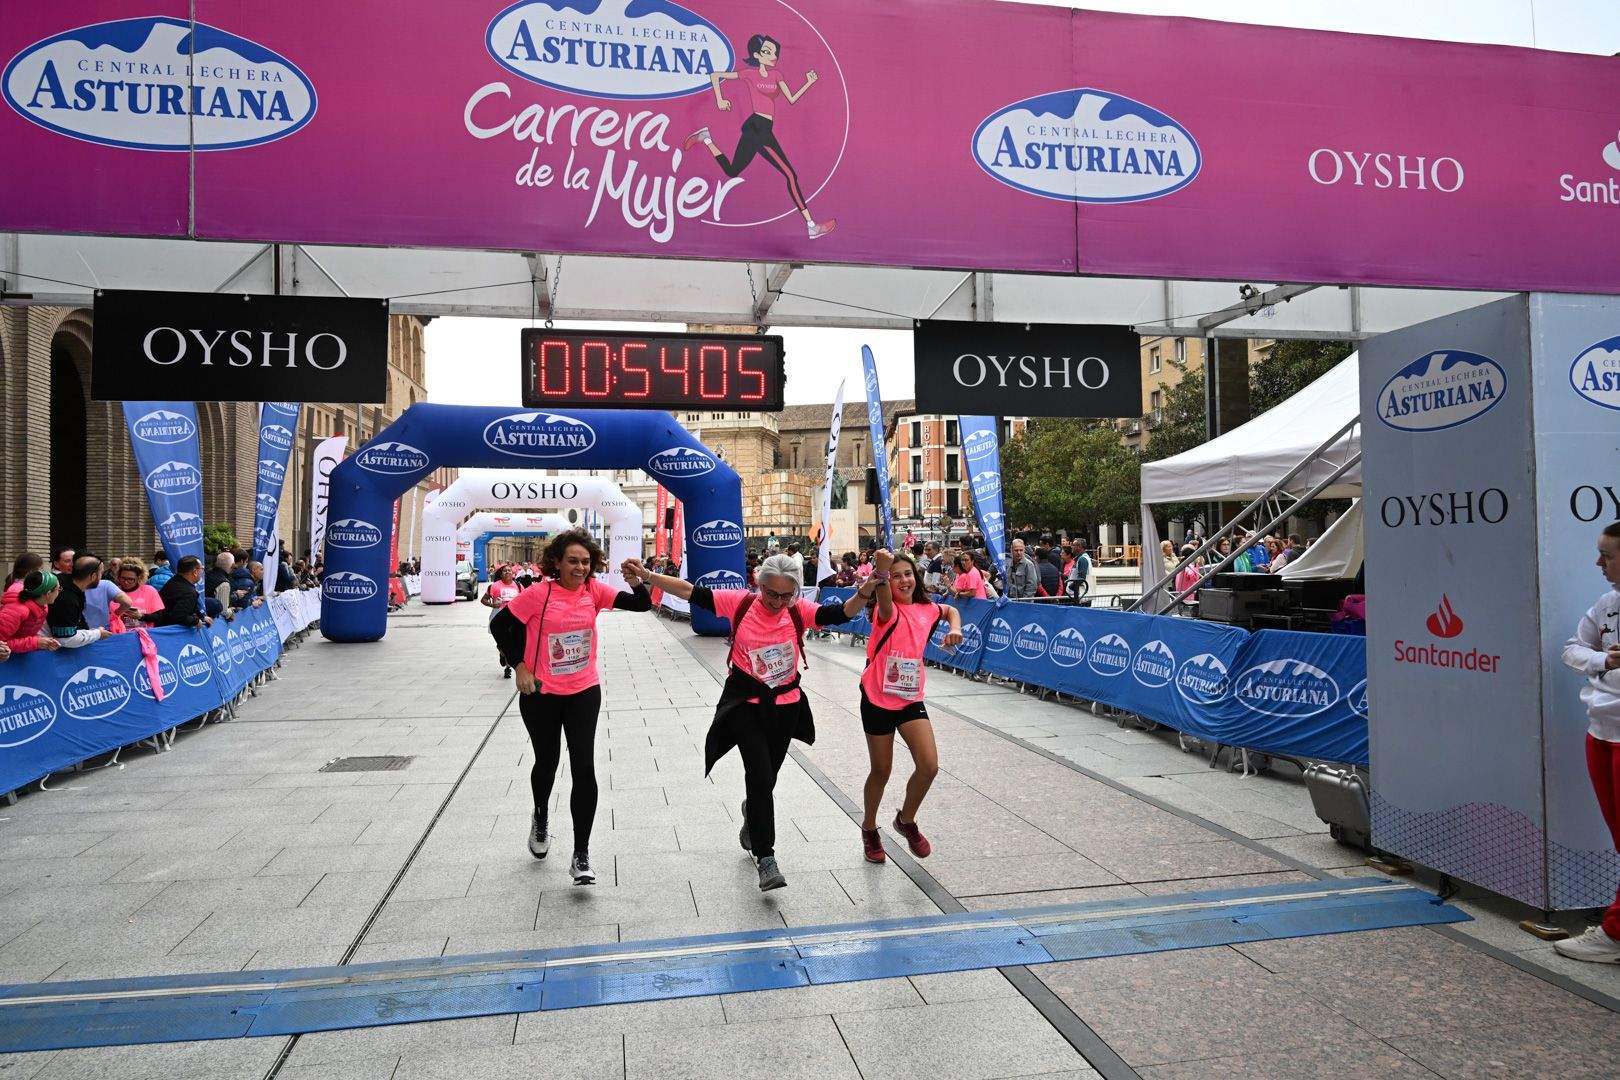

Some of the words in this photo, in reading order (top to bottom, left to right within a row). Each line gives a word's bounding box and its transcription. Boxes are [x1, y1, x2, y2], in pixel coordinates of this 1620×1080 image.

[545, 19, 624, 36] CENTRAL
[631, 26, 708, 43] LECHERA
[506, 19, 715, 75] ASTURIANA
[78, 59, 175, 76] CENTRAL
[187, 65, 284, 83] LECHERA
[27, 60, 294, 122] ASTURIANA
[464, 82, 670, 152] Carrera
[1027, 124, 1099, 140] CENTRAL
[1105, 129, 1177, 145] LECHERA
[991, 125, 1184, 178] ASTURIANA
[1308, 148, 1464, 192] OYSHO
[515, 148, 554, 188] de
[563, 153, 591, 191] la
[584, 148, 745, 244] Mujer
[1559, 173, 1620, 205] Sant
[143, 326, 347, 370] OYSHO
[953, 353, 1110, 390] OYSHO
[1603, 359, 1620, 368] CE
[1401, 375, 1442, 393] CENTRAL
[1446, 367, 1490, 385] LECHERA
[1384, 379, 1496, 419] ASTURIANA
[492, 426, 588, 447] ASTURIANA
[360, 452, 423, 467] ASTURIANA
[654, 459, 712, 470] ASTURIANA
[491, 482, 578, 500] OYSHO
[1380, 488, 1509, 528] OYSHO
[328, 530, 378, 542] ASTURIANA
[696, 532, 740, 542] ASTURIANA
[324, 582, 372, 594] ASTURIANA
[1016, 636, 1045, 652] ASTURIANA
[1051, 640, 1083, 660] ASTURIANA
[1394, 640, 1501, 674] Santander
[1090, 650, 1128, 669] ASTURIANA
[68, 684, 128, 712] ASTURIANA
[1240, 676, 1330, 706] ASTURIANA
[0, 704, 52, 735] TURIANA
